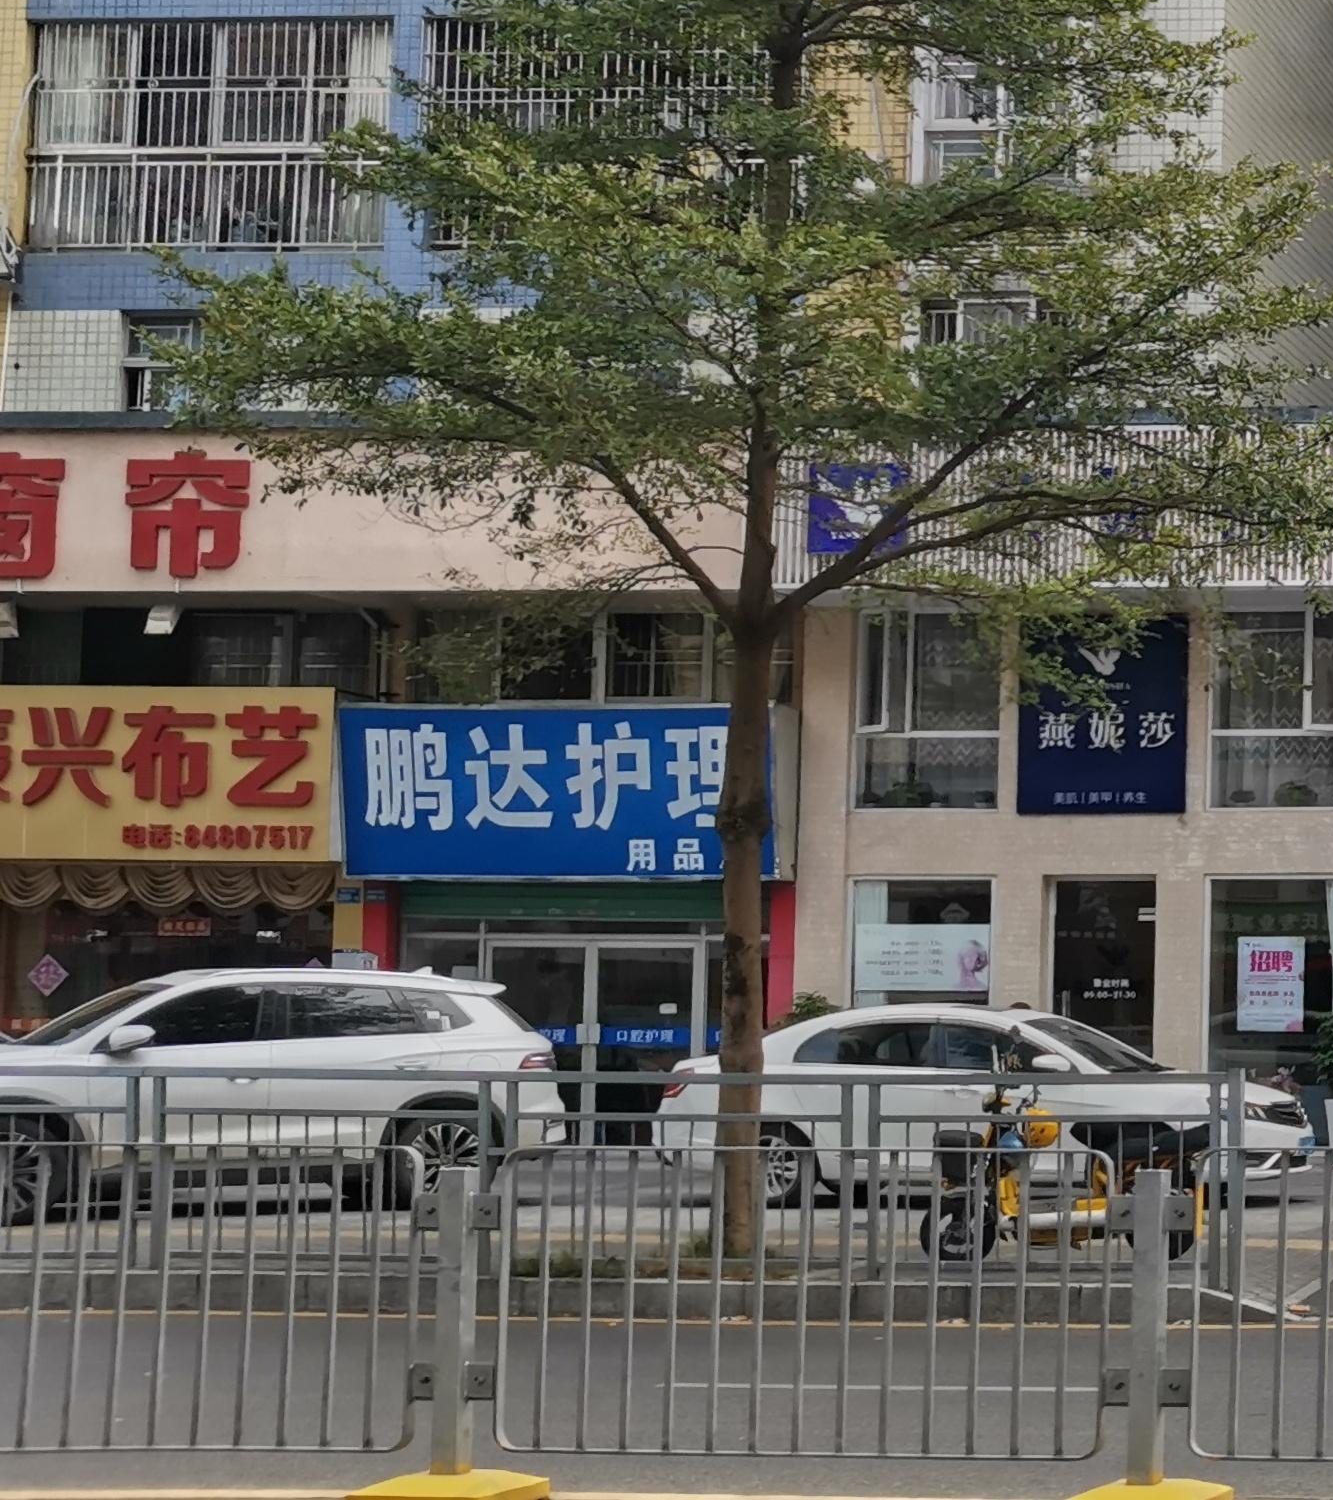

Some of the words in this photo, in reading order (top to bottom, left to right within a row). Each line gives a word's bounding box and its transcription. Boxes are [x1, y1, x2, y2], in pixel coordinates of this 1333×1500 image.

[0, 705, 319, 809] 兴布艺
[1038, 710, 1176, 750] 燕妮莎
[363, 721, 732, 833] 鹏达护理
[1249, 950, 1293, 973] 招聘
